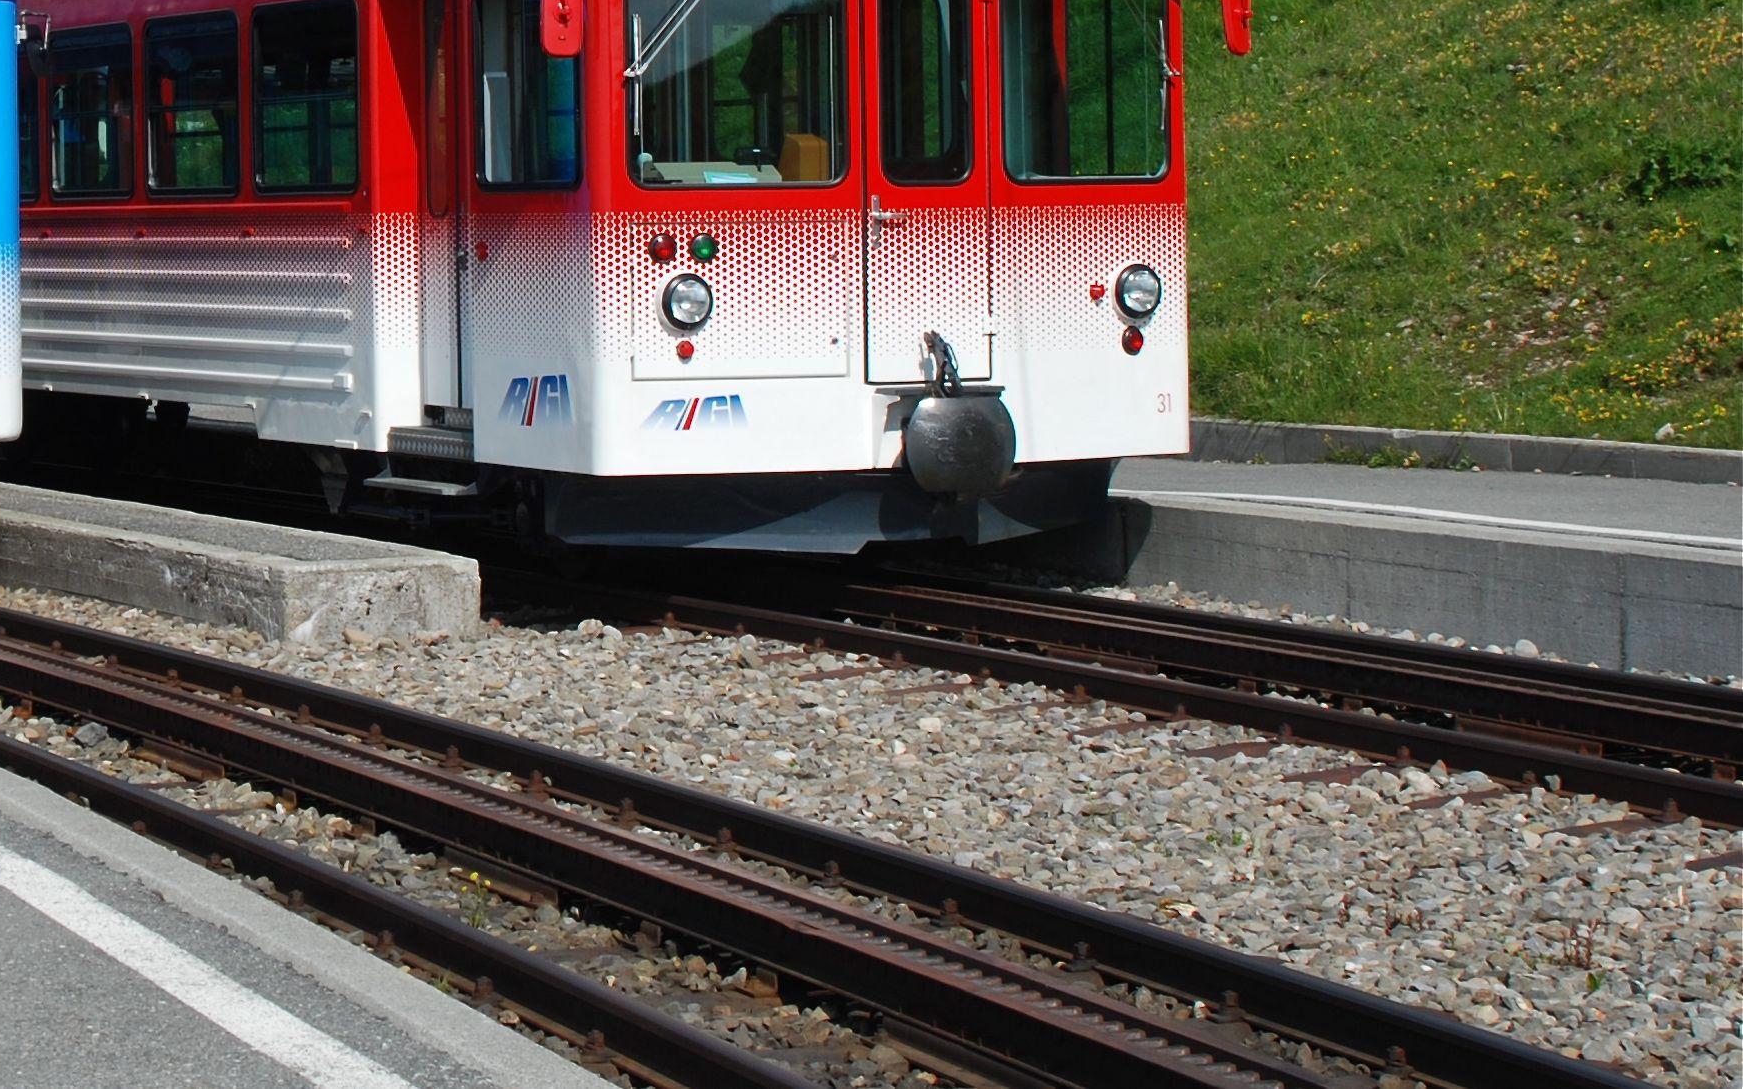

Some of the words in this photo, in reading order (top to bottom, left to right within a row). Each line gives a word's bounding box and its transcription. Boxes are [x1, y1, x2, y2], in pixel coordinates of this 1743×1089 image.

[497, 374, 574, 426] RIGI
[640, 394, 749, 430] RIGI
[1157, 393, 1171, 413] 31
